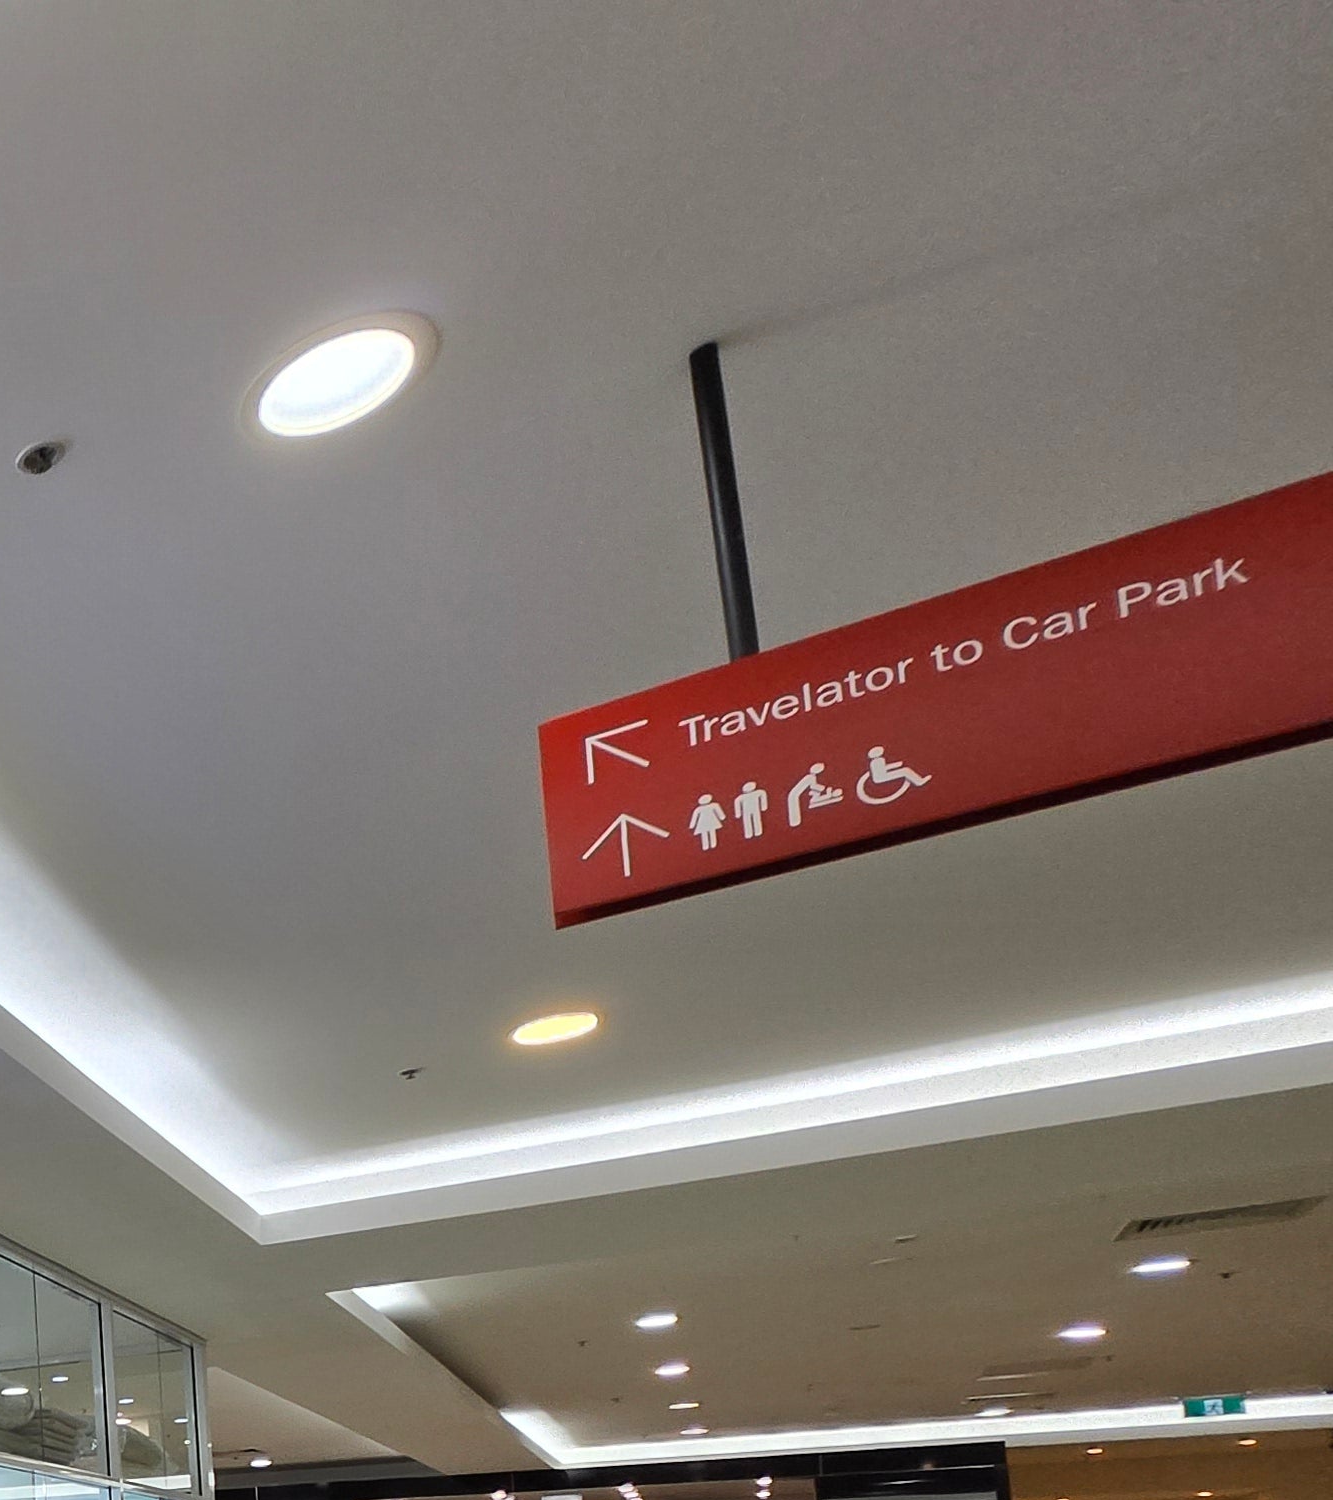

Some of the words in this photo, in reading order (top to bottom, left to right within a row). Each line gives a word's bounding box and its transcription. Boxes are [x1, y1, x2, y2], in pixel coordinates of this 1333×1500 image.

[678, 657, 914, 749] Travelator
[930, 639, 983, 673] to
[1002, 598, 1097, 653] Car
[1115, 554, 1250, 621] Park
